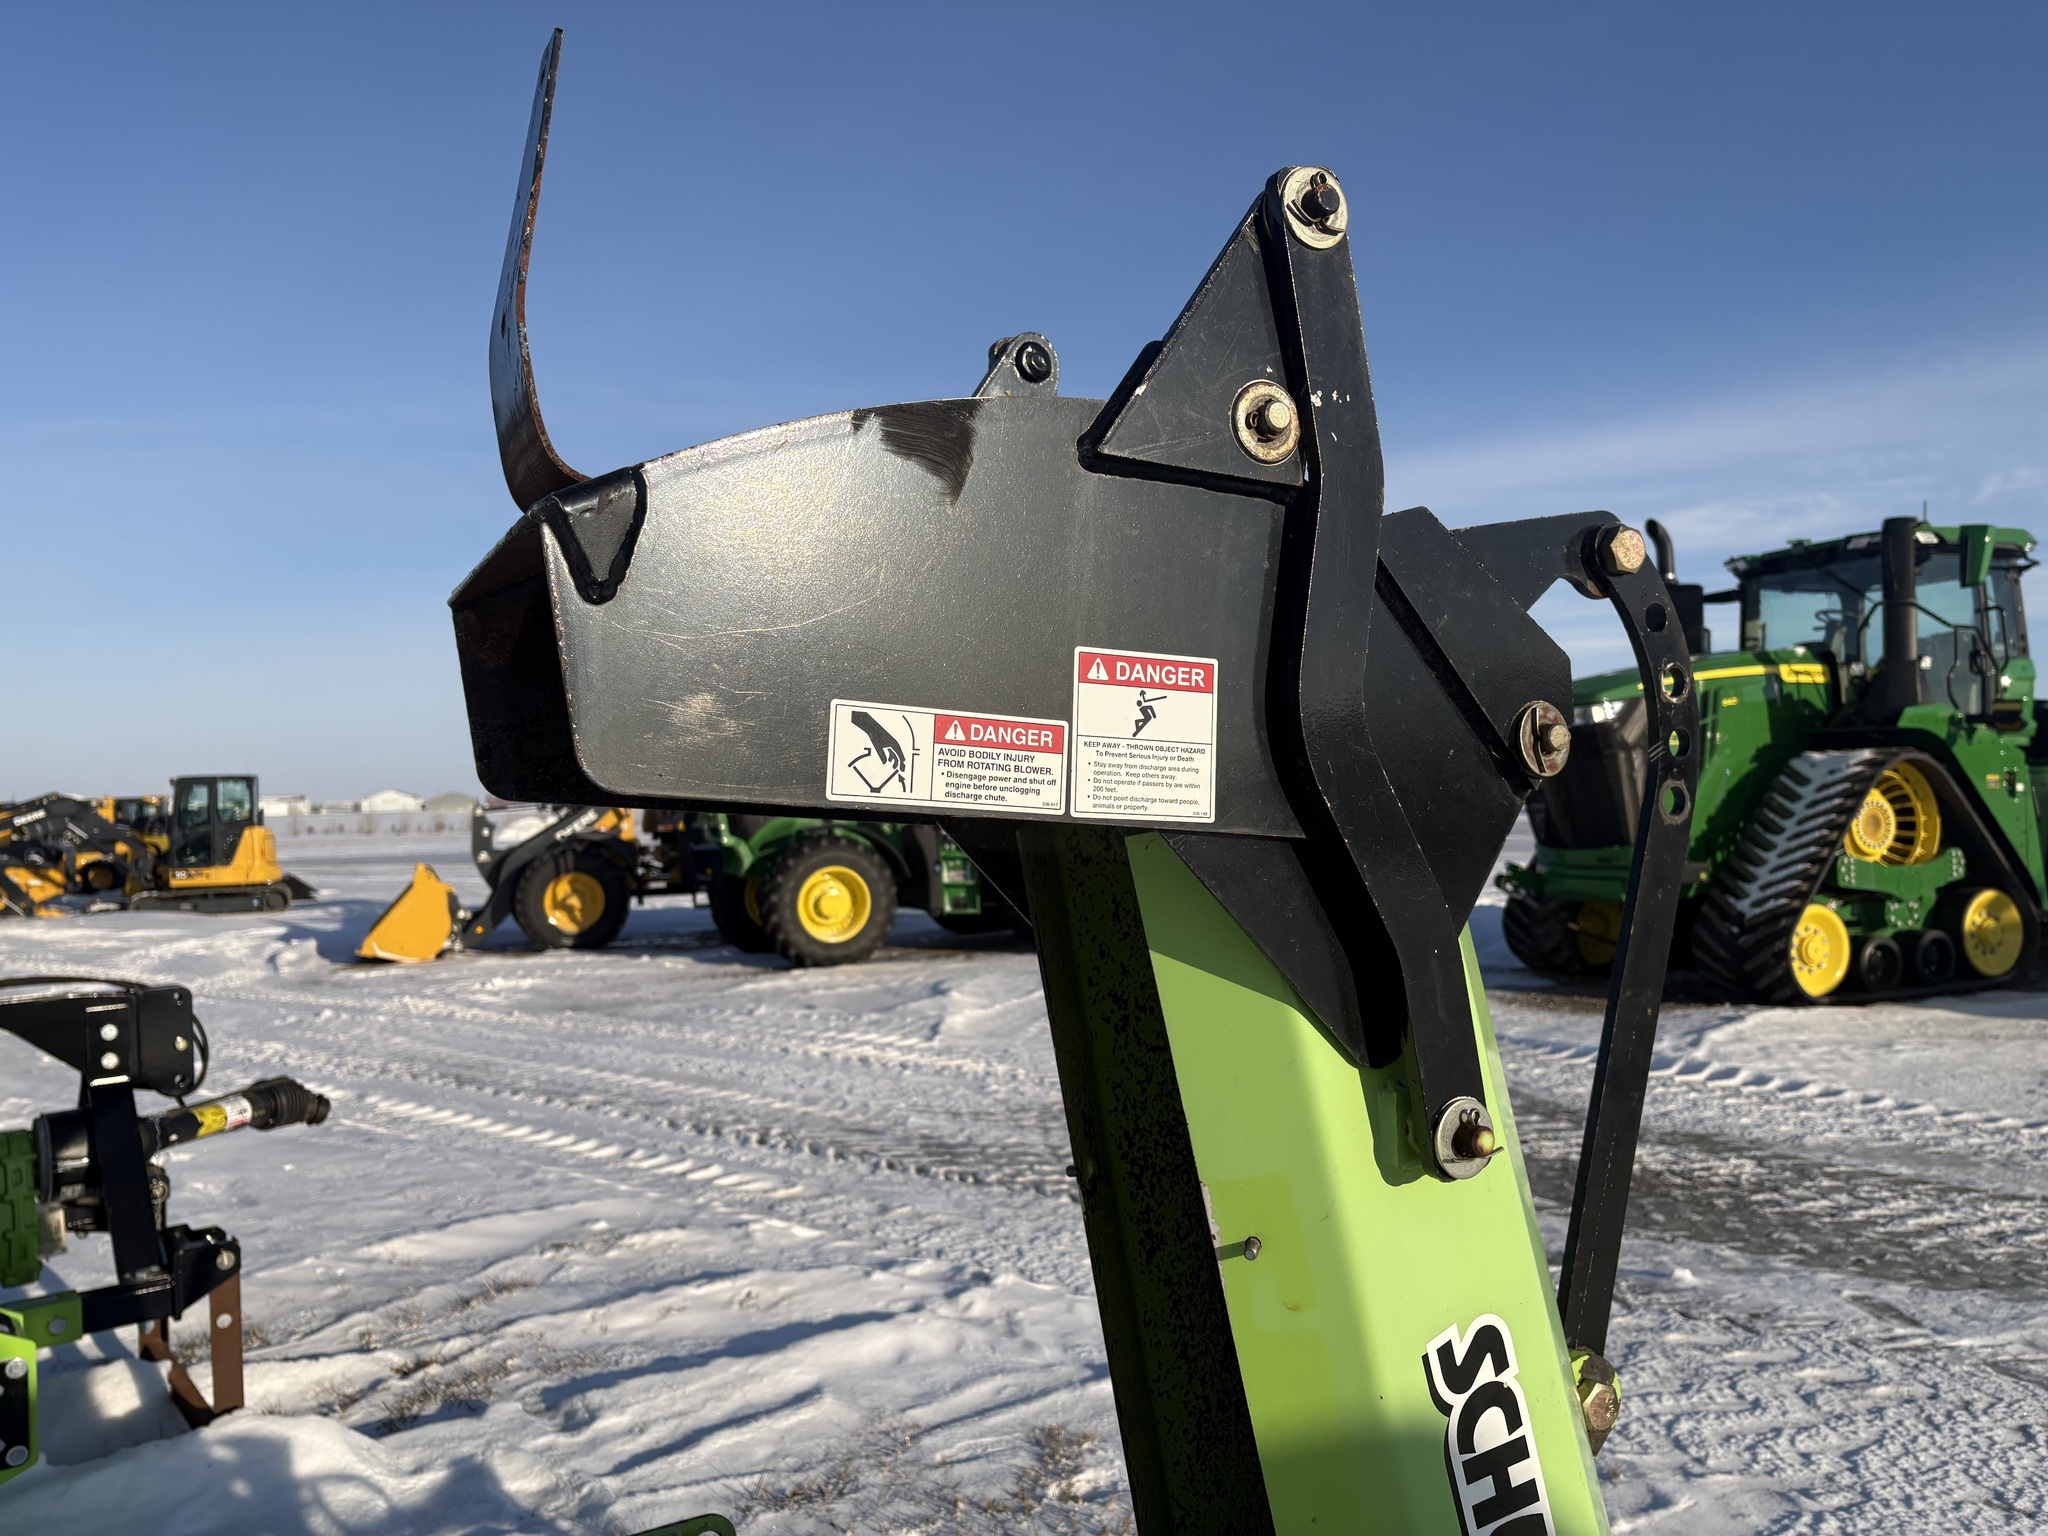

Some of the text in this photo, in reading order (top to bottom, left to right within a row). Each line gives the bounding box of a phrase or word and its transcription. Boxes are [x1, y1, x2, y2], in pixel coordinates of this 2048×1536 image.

[1116, 662, 1205, 687] DANGER
[970, 724, 1053, 747] DANGER
[938, 748, 1035, 763] AVOID BODILY INJURY
[1152, 754, 1168, 762] Injury
[938, 759, 1053, 775] FROM ROTATING BLOWER.
[1139, 764, 1166, 772] discharge
[947, 771, 986, 782] Disengage
[989, 775, 1011, 783] power
[945, 782, 971, 790] engine
[1000, 786, 1040, 796] unclogging
[945, 791, 1007, 802] discharge chute.
